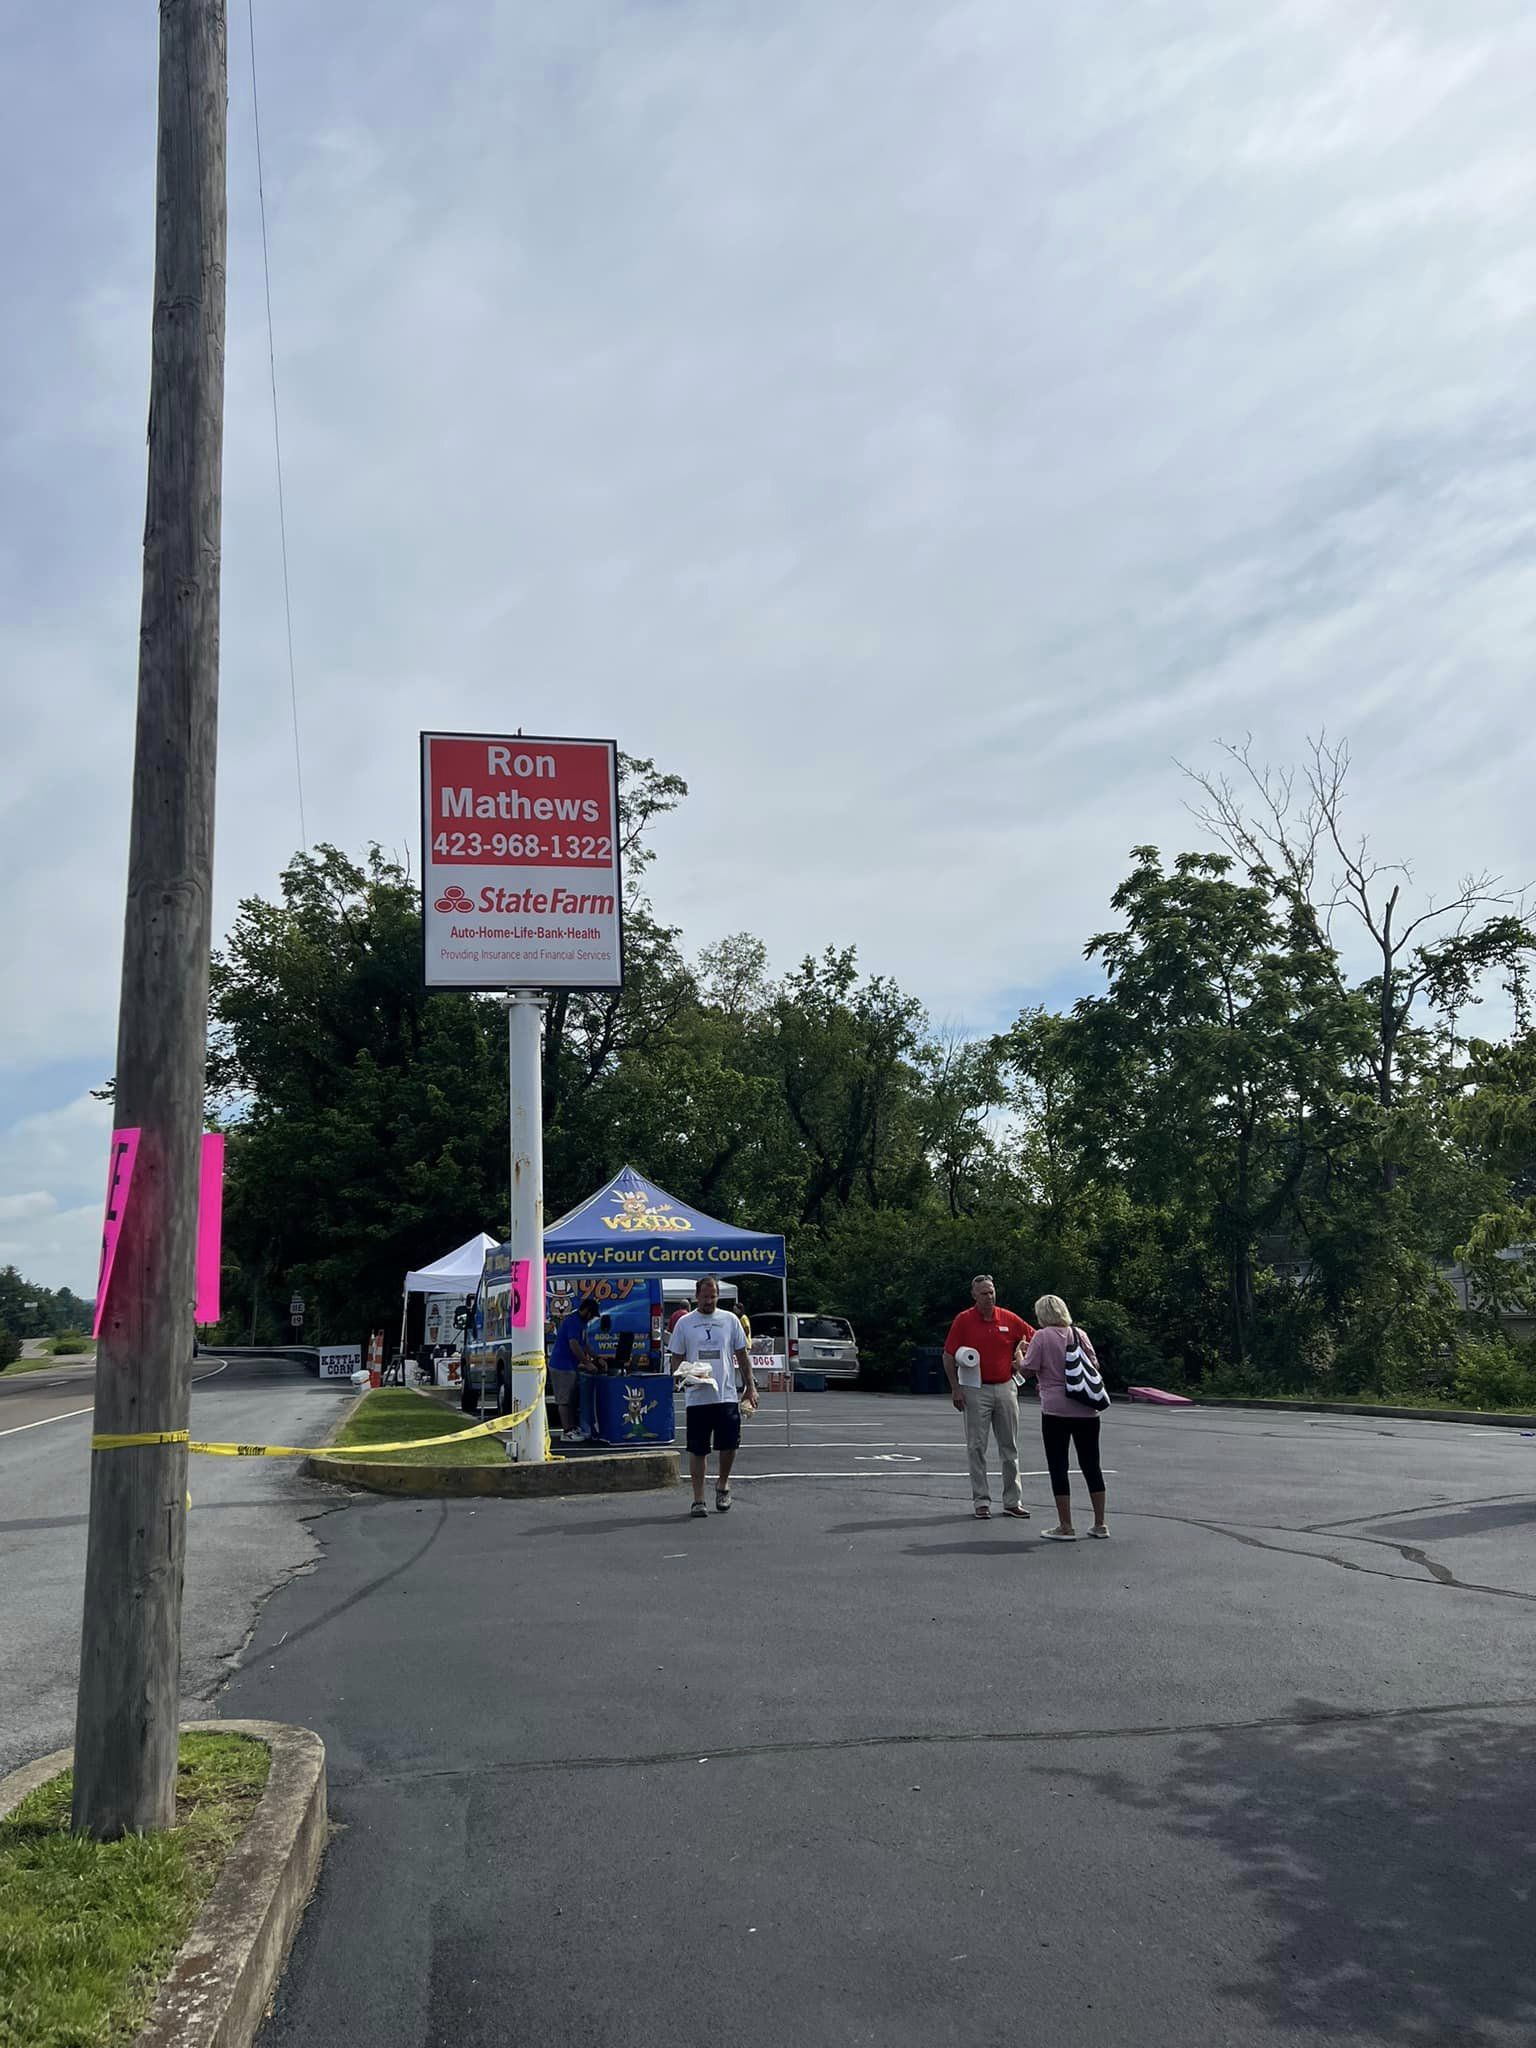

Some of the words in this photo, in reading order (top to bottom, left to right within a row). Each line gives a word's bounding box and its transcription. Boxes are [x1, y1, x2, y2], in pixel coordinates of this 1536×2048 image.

[487, 745, 556, 778] Ron
[441, 787, 599, 822] Mathews
[433, 832, 612, 860] 423-968-1322
[440, 949, 479, 961] Providing
[481, 950, 521, 959] Insurance
[523, 950, 538, 960] and
[540, 950, 575, 960] Financial
[576, 950, 611, 960] Services
[545, 1248, 644, 1267] wenty-Four
[648, 1246, 704, 1263] Carrot
[708, 1246, 777, 1265] Country
[321, 1354, 361, 1366] KETTLE
[753, 1356, 775, 1366] DOGS
[327, 1364, 354, 1375] CORN
